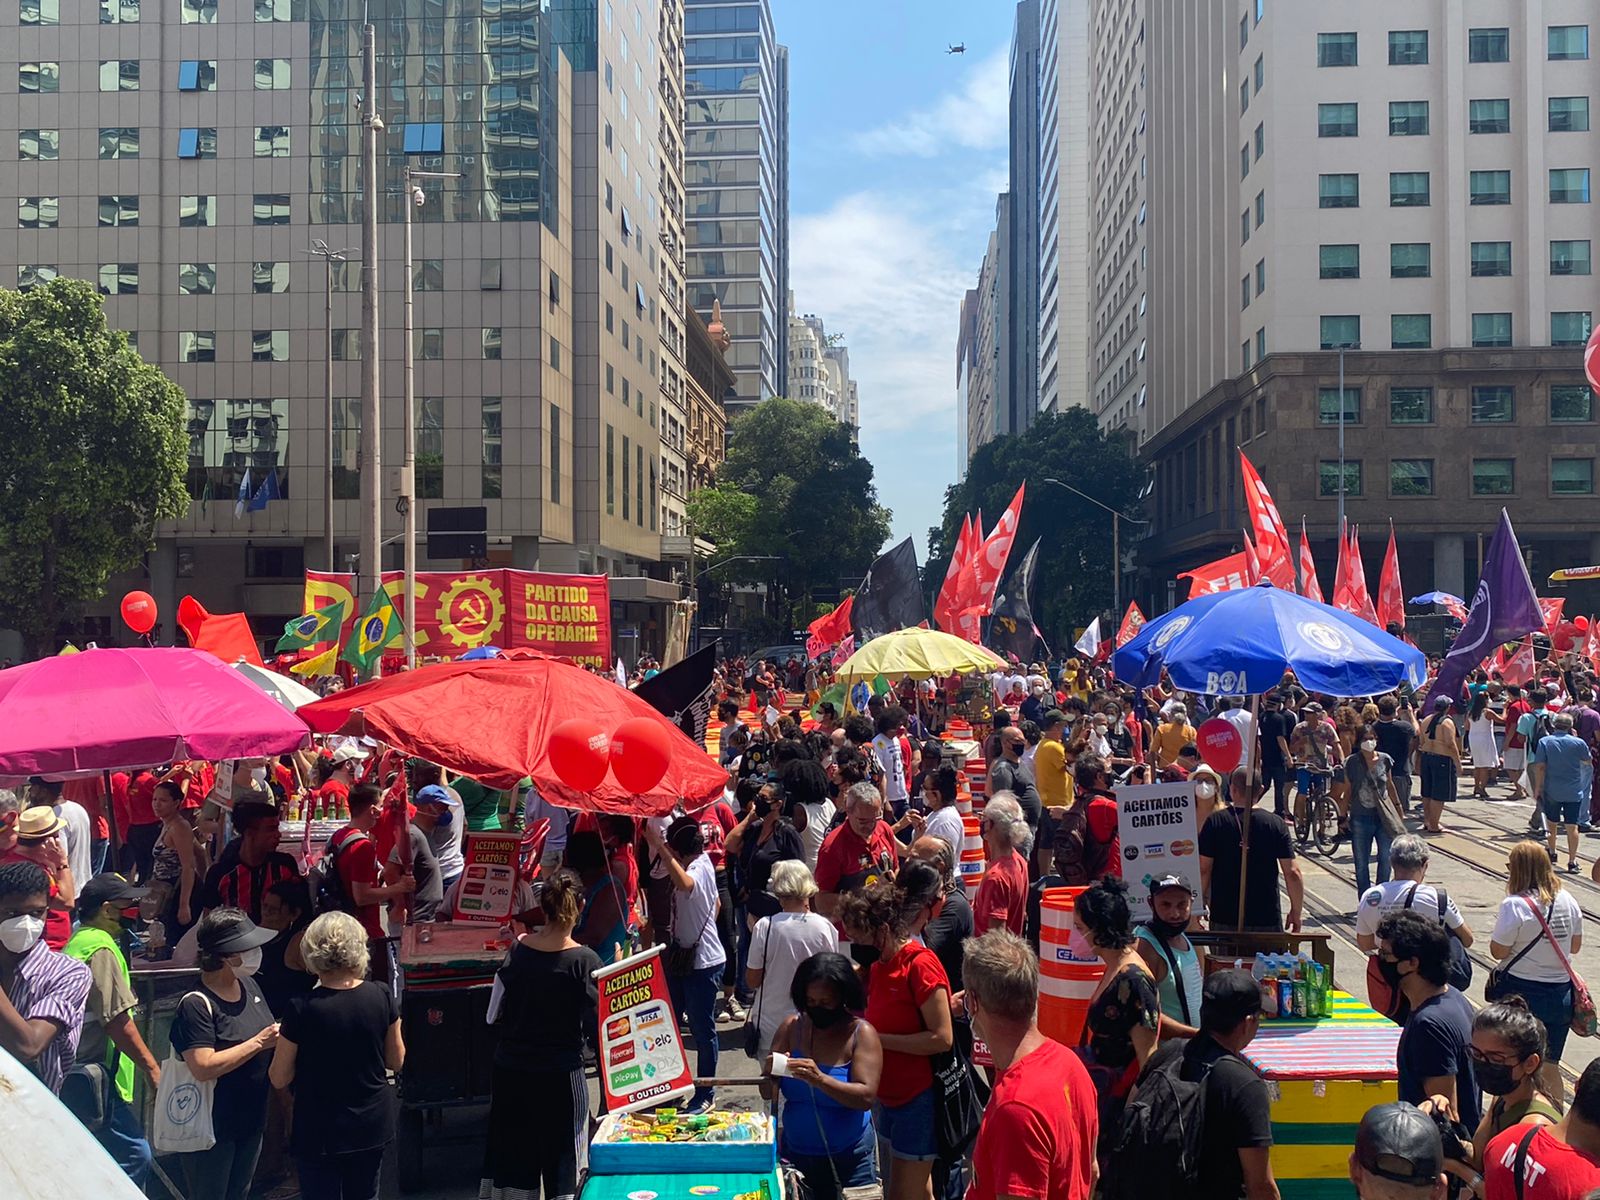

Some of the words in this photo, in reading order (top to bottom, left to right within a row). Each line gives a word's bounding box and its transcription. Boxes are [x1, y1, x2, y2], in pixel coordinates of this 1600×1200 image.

[525, 583, 589, 603] PARTIDO
[525, 603, 547, 620] DA
[550, 605, 598, 622] CAUSA
[525, 622, 598, 642] OPERÁRIA
[1124, 795, 1188, 813] ACEITAMOS
[1131, 810, 1183, 828] CARTÕES
[474, 841, 514, 851] ACEITAMOS
[475, 852, 508, 864] CARTÕES
[605, 963, 653, 996] ACEITAMOS
[610, 985, 651, 1012] CARTÕES
[640, 1012, 658, 1023] VISA
[629, 1094, 636, 1103] E
[636, 1083, 672, 1100] OUTROS
